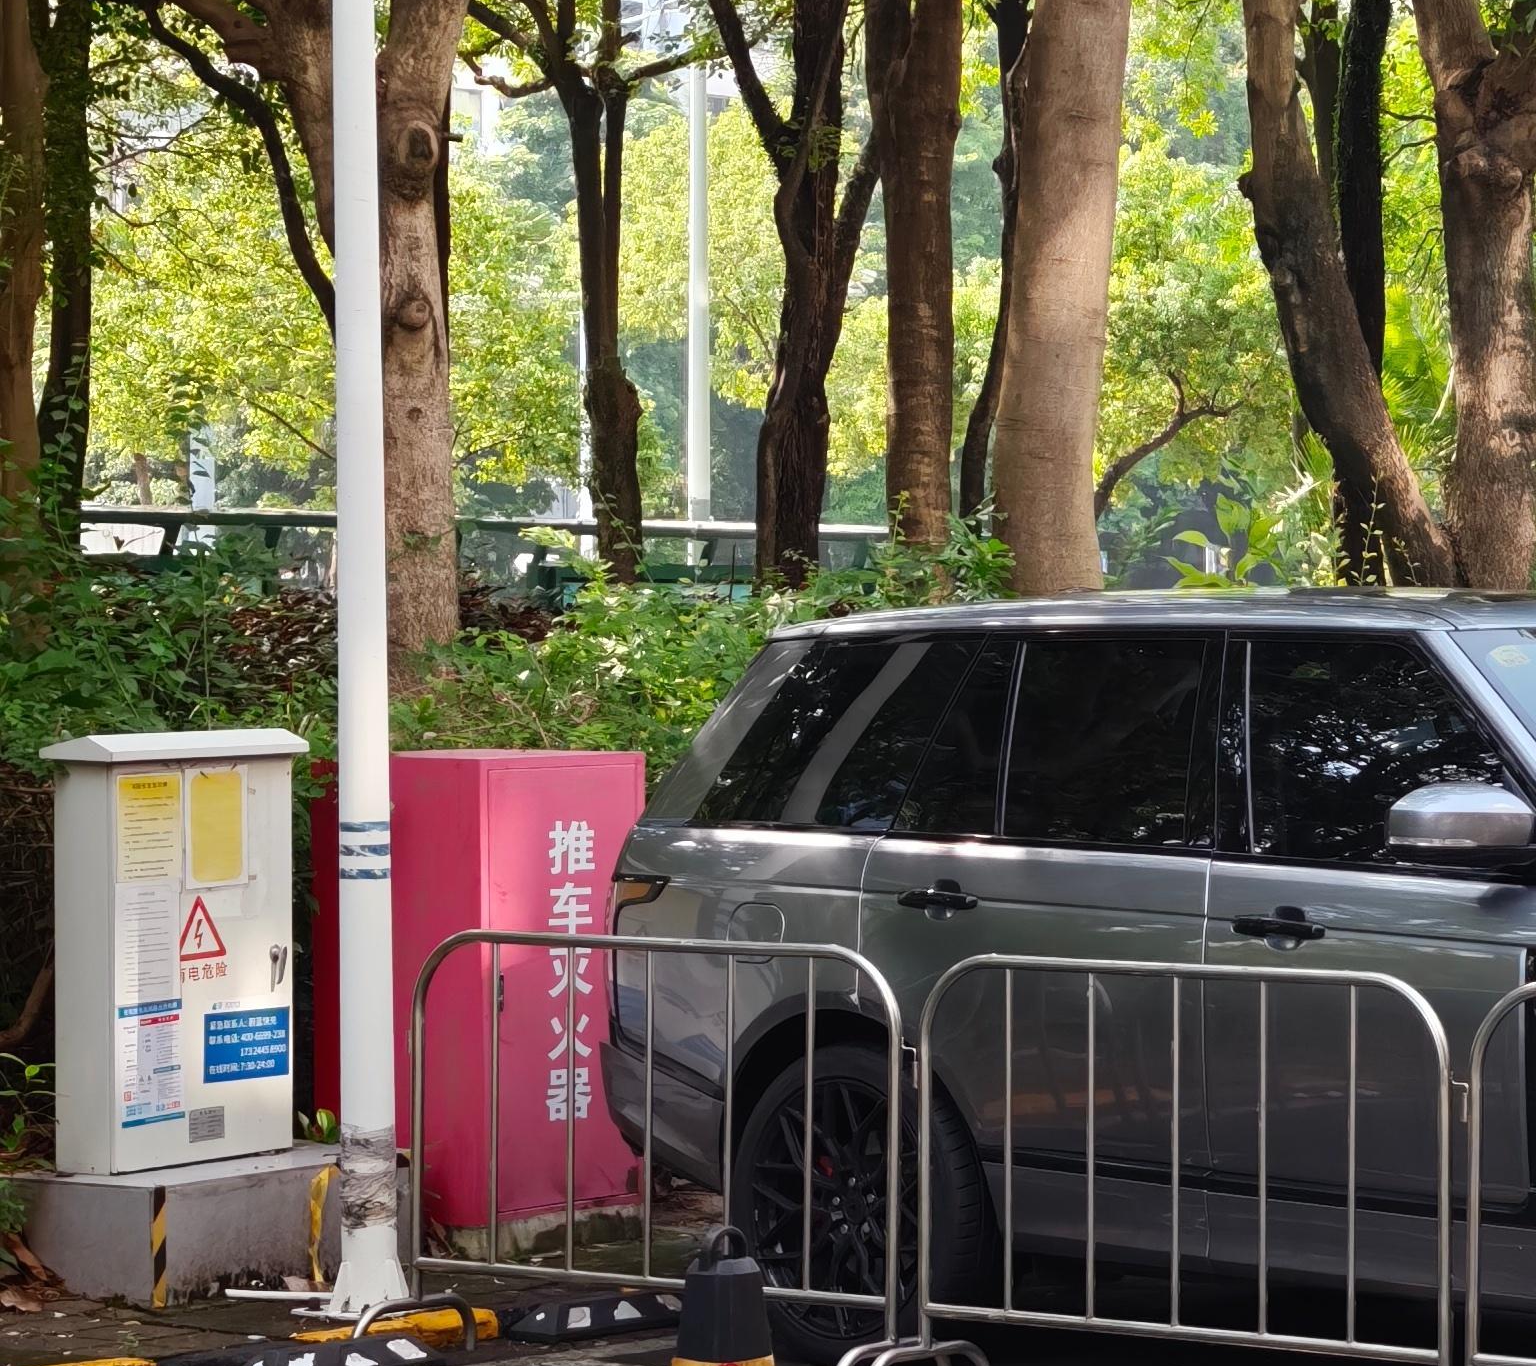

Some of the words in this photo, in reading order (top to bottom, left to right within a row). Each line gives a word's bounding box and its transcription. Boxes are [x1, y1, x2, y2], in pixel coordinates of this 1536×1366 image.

[546, 820, 596, 1122] 推车灭火器
